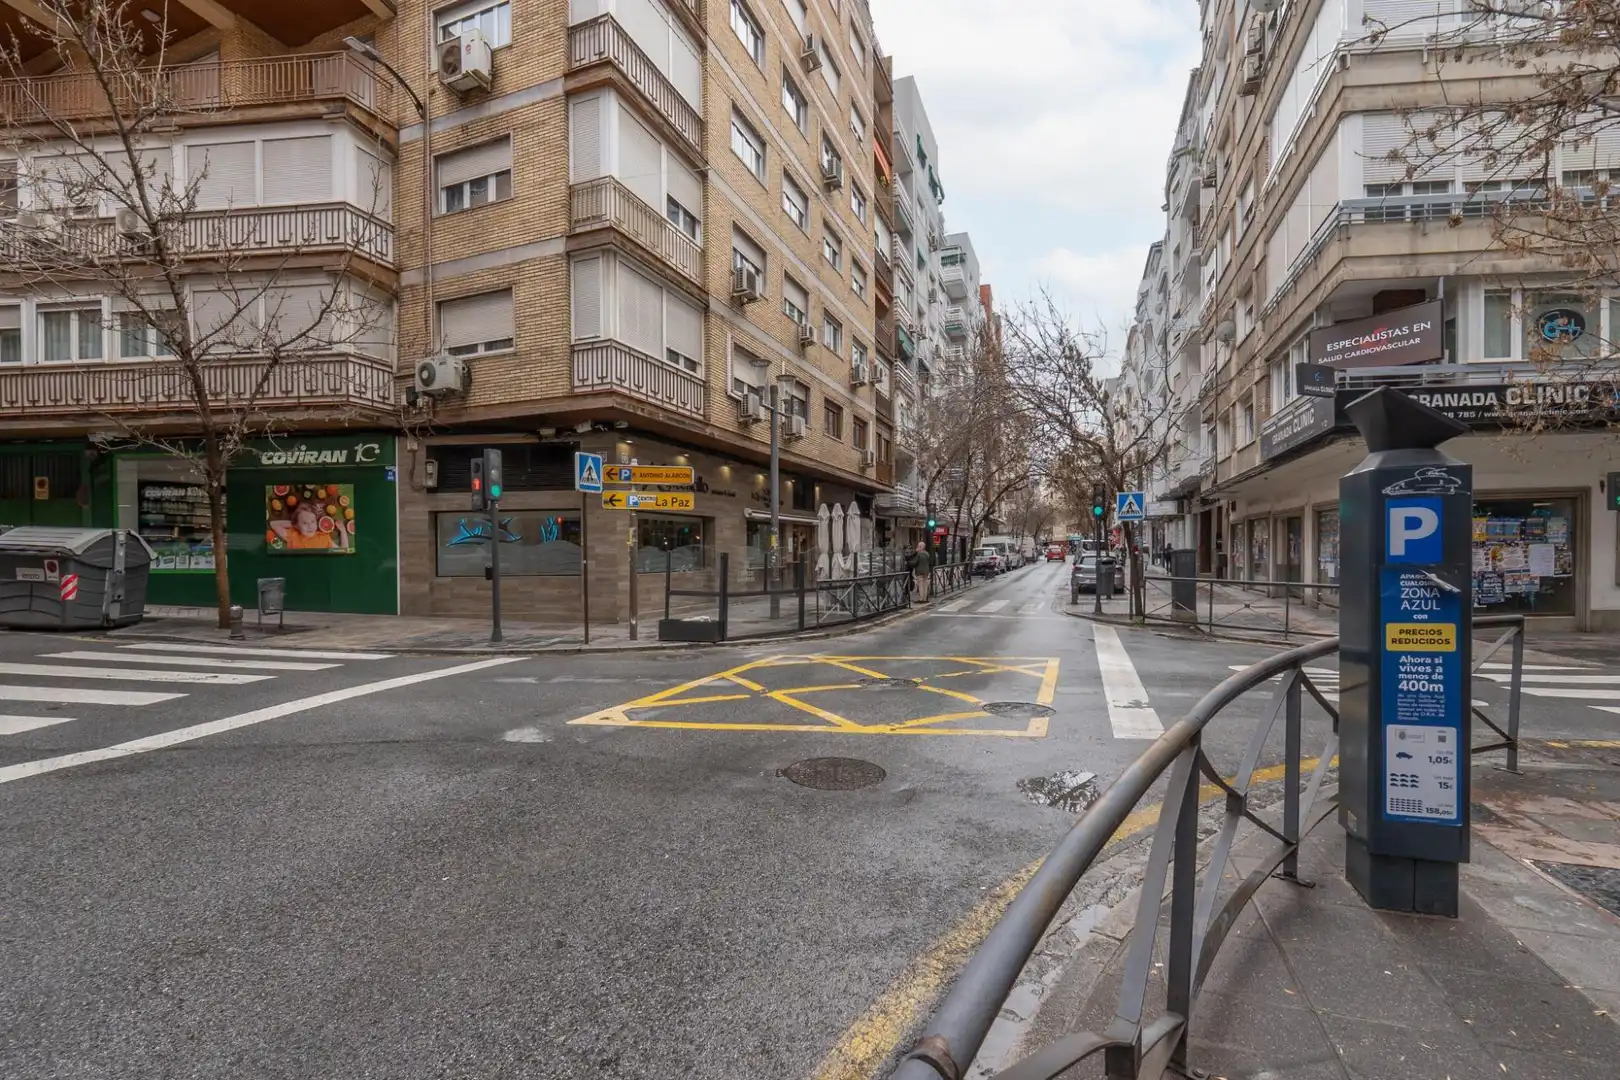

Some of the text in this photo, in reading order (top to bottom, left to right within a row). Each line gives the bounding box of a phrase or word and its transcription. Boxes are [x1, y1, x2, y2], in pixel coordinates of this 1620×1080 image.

[1326, 321, 1431, 351] ESPECIALISTAS EN
[1318, 337, 1421, 364] SALUD CARDIOVASCULAR
[1505, 385, 1589, 405] CLINIC
[1293, 407, 1315, 433] CLINIC
[655, 496, 668, 506] La
[671, 496, 690, 507] Paz
[1389, 507, 1438, 556] P
[1400, 587, 1440, 598] ZONA
[1400, 599, 1441, 610] AZUL
[1398, 655, 1443, 663] Ahora si
[1398, 663, 1432, 672] vives
[1431, 672, 1444, 680] de
[1398, 680, 1444, 692] 400m
